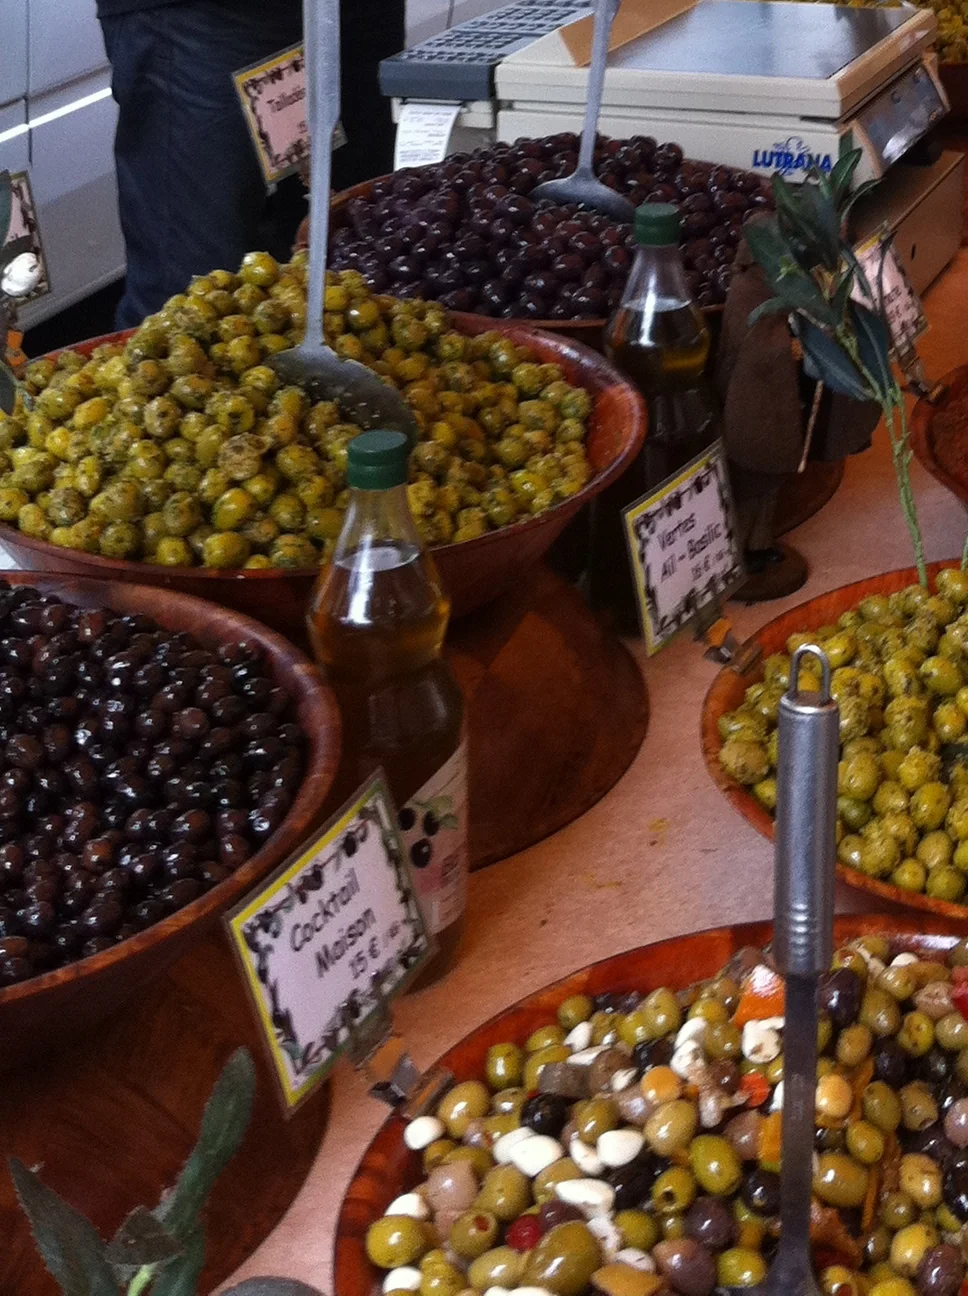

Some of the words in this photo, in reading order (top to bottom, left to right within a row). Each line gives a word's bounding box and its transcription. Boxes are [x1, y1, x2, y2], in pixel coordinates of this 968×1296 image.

[688, 522, 721, 560] Basilic
[291, 868, 360, 951] Cocktail
[316, 908, 376, 978] Maison
